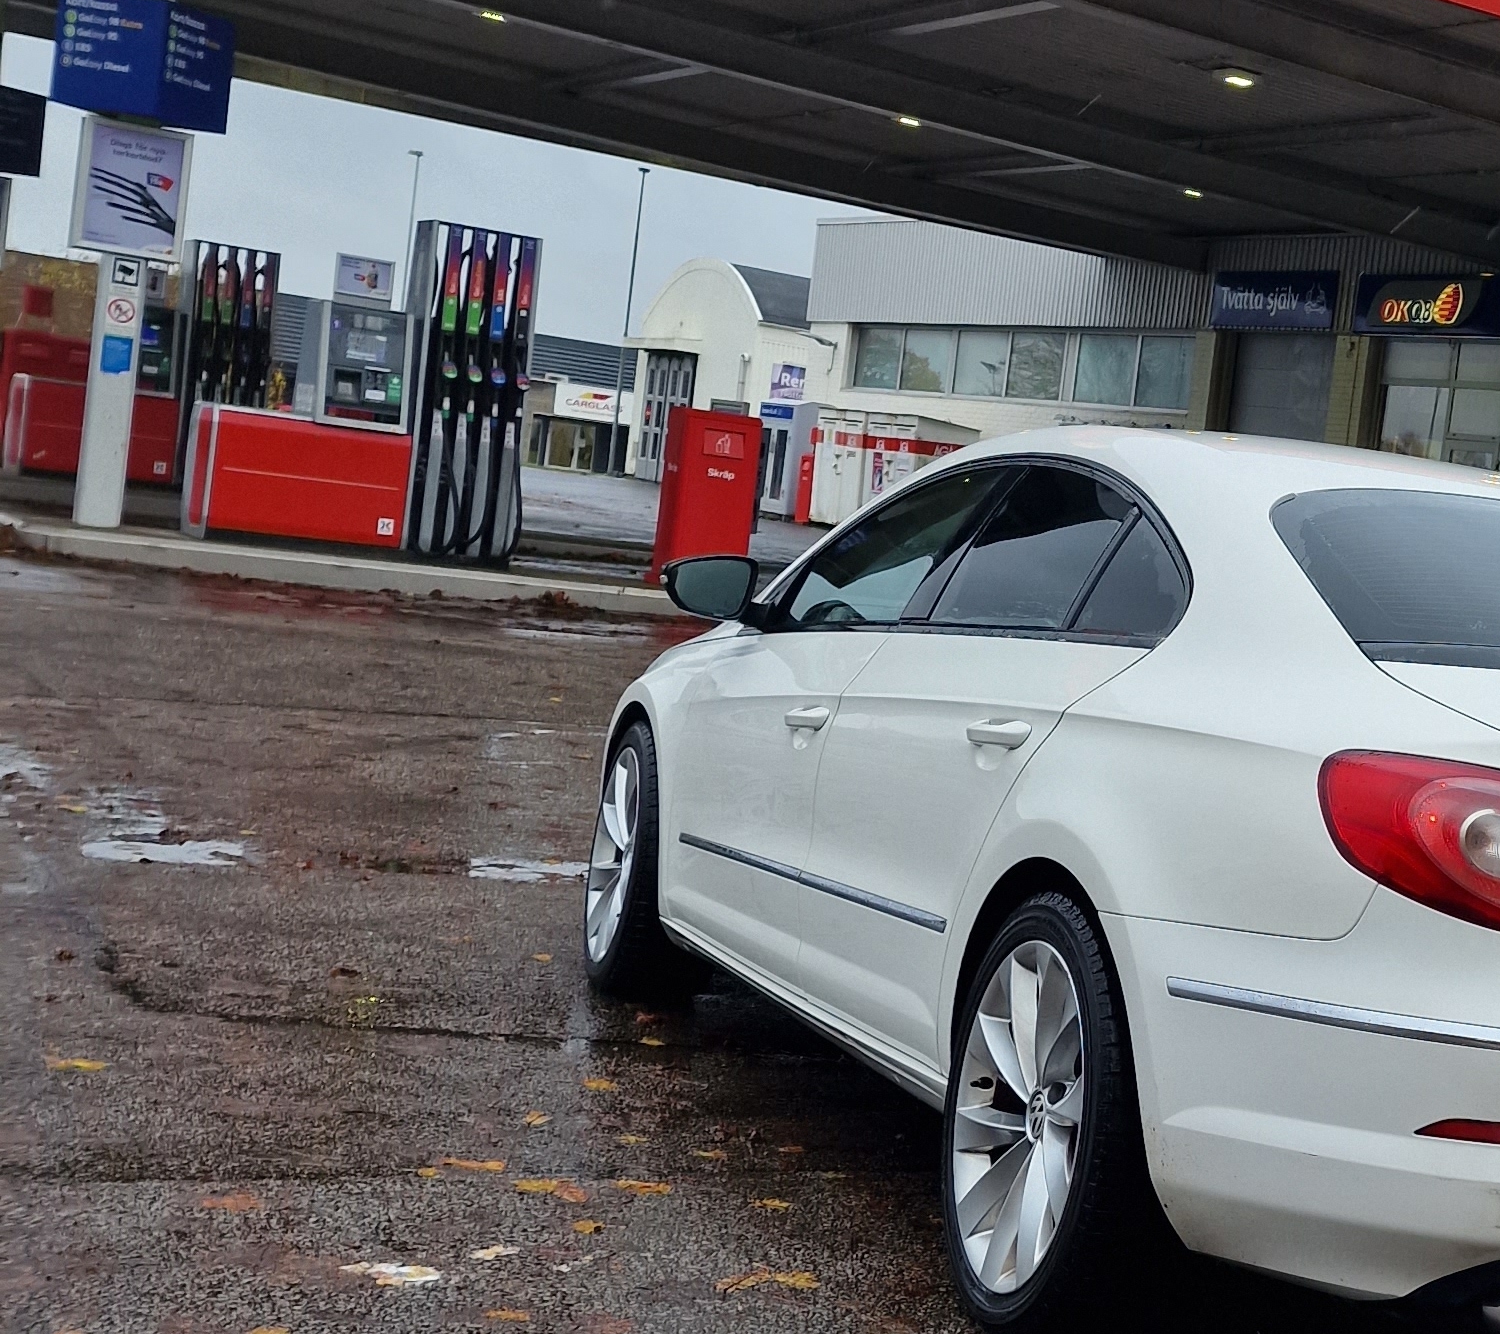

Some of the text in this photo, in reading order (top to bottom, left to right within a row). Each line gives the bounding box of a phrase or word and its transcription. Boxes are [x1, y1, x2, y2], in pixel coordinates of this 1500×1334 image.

[1221, 285, 1299, 316] Tvätta själv
[1380, 298, 1434, 324] OKQ8
[707, 467, 735, 481] Skräp
